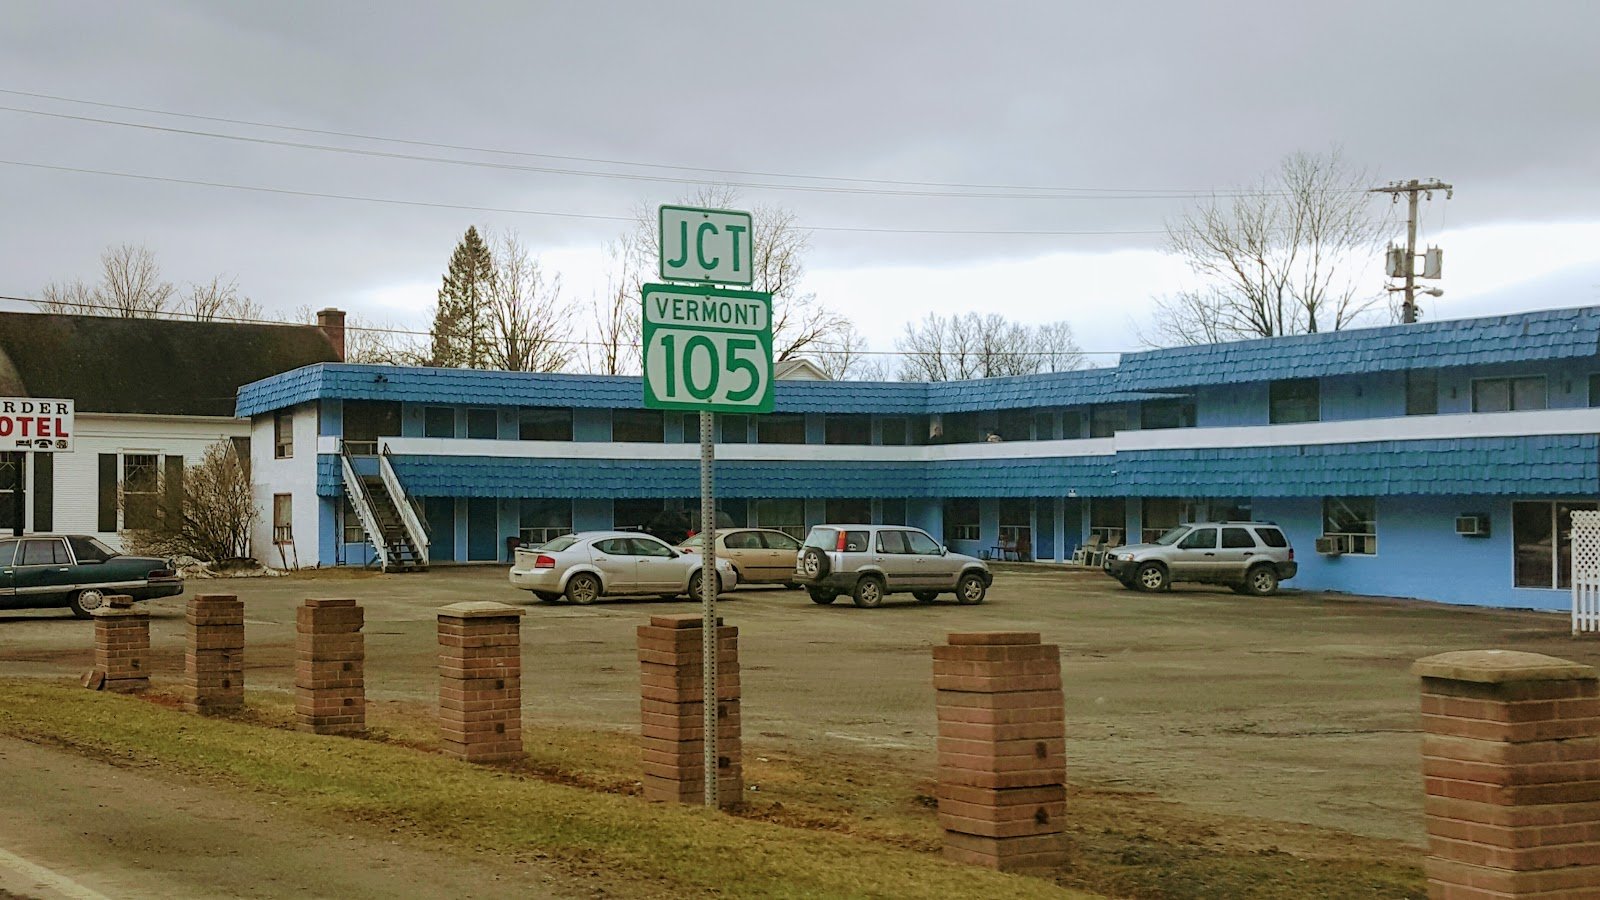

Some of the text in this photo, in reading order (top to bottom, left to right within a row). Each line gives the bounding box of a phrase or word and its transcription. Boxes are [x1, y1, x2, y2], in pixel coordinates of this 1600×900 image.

[667, 221, 746, 272] JCT
[655, 297, 760, 325] VERMONT
[660, 334, 760, 402] 105
[0, 416, 69, 437] OTEL
